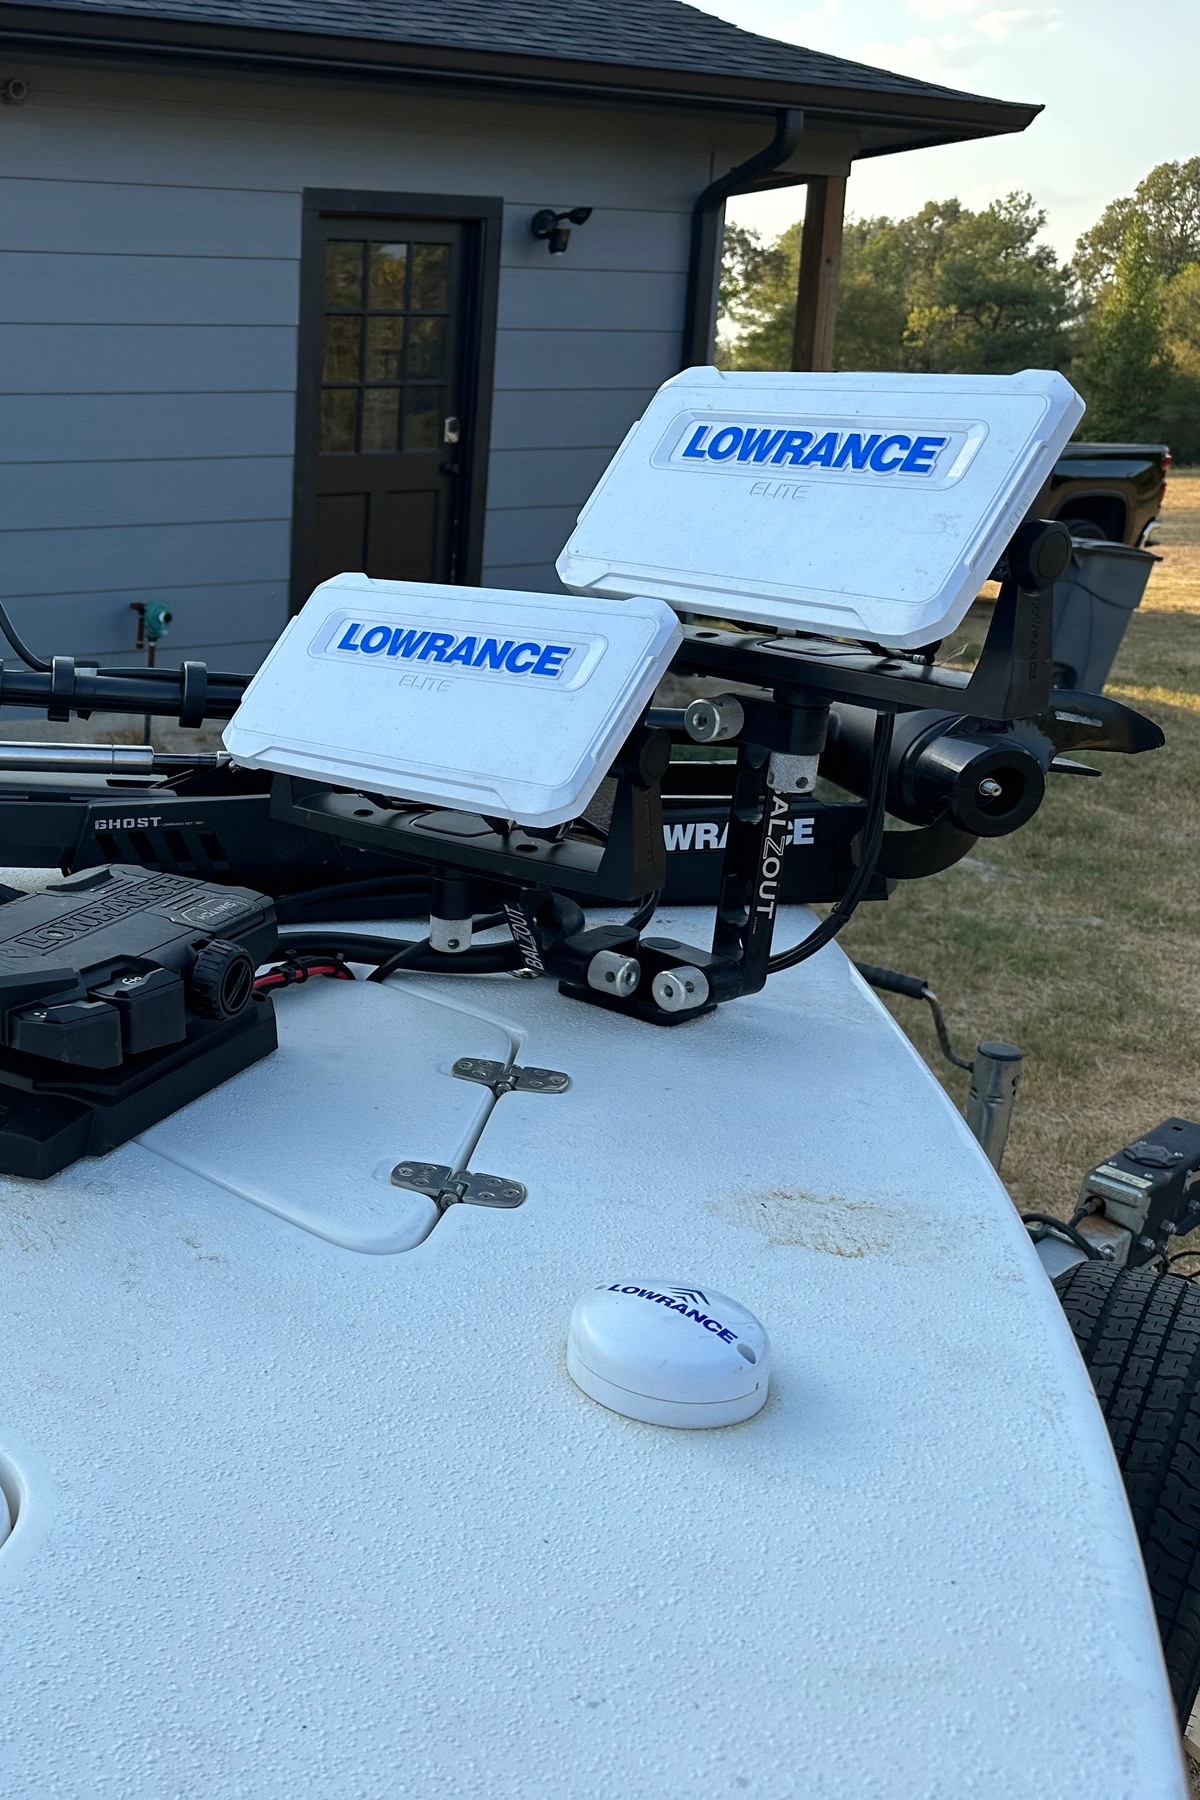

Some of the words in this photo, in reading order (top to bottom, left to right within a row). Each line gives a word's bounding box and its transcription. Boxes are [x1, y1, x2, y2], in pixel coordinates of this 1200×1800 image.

[682, 425, 947, 474] LOWRANCE
[749, 480, 812, 500] ELITE
[337, 623, 572, 677] LOWRANCE
[399, 673, 454, 692] ELITE
[94, 816, 162, 830] GHOST
[756, 790, 789, 920] ALZOUT
[14, 876, 195, 950] LOWRANCE
[503, 903, 545, 971] BALZOUT
[606, 1283, 739, 1345] LOWRANCE
